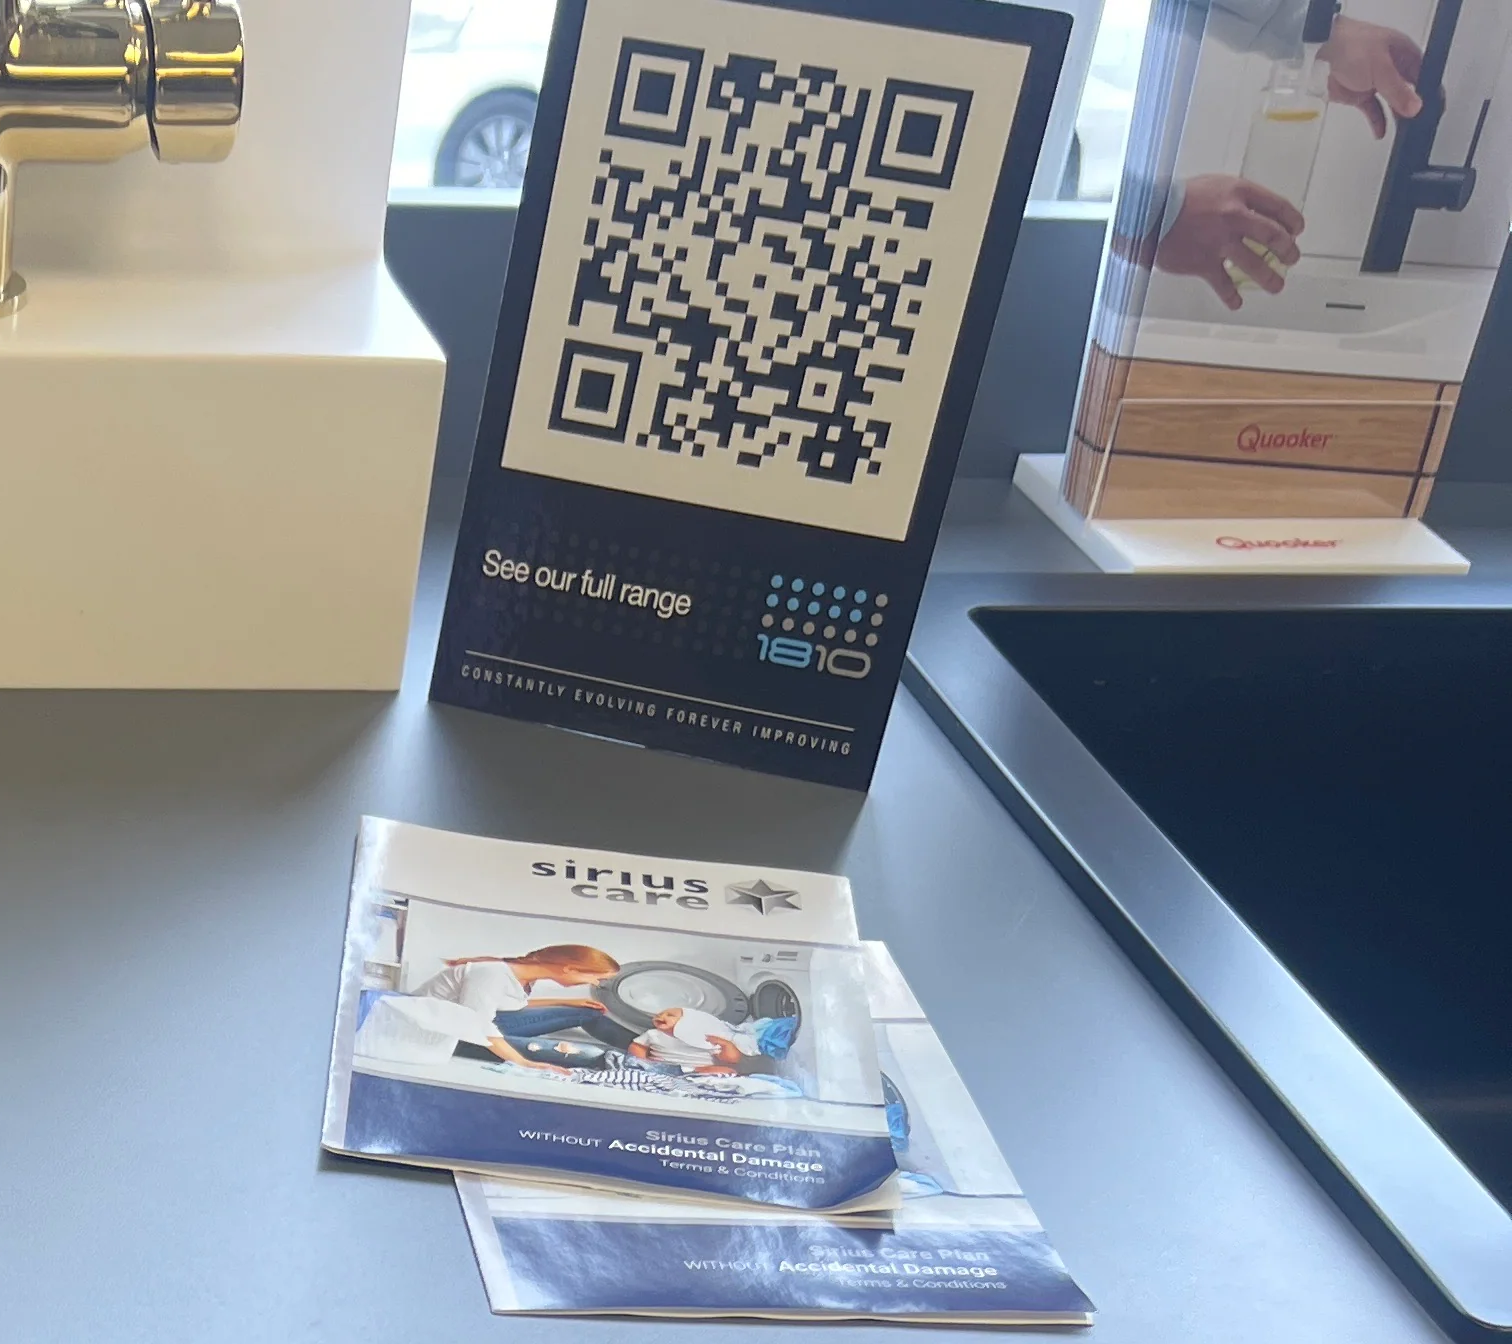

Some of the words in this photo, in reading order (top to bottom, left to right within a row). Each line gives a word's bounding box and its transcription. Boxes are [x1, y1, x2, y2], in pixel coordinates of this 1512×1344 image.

[1237, 423, 1334, 453] Quooker
[482, 548, 530, 583] See
[534, 566, 578, 592] our
[581, 569, 616, 601] full
[619, 582, 692, 619] range
[757, 633, 872, 680] 1810
[460, 663, 566, 697] CONSTANTLY
[574, 688, 657, 717] EVOLVING
[666, 707, 743, 735] FOREVER
[752, 725, 851, 756] IMPROVING
[531, 859, 709, 894] sirius
[570, 883, 710, 911] care
[518, 1129, 602, 1148] WITHOUT
[608, 1139, 725, 1162] Accidental
[732, 1152, 824, 1173] Damage
[645, 1130, 708, 1146] Sirius
[715, 1137, 766, 1153] Care
[773, 1143, 821, 1158] Plan
[661, 1158, 713, 1174] Terms
[717, 1165, 730, 1175] &
[734, 1167, 825, 1185] Conditions
[880, 1246, 932, 1260] Care
[941, 1249, 989, 1262] Plan
[779, 1260, 898, 1275] Accidental
[906, 1263, 998, 1278] Damage
[897, 1279, 909, 1289] &
[912, 1278, 1007, 1290] Conditions
